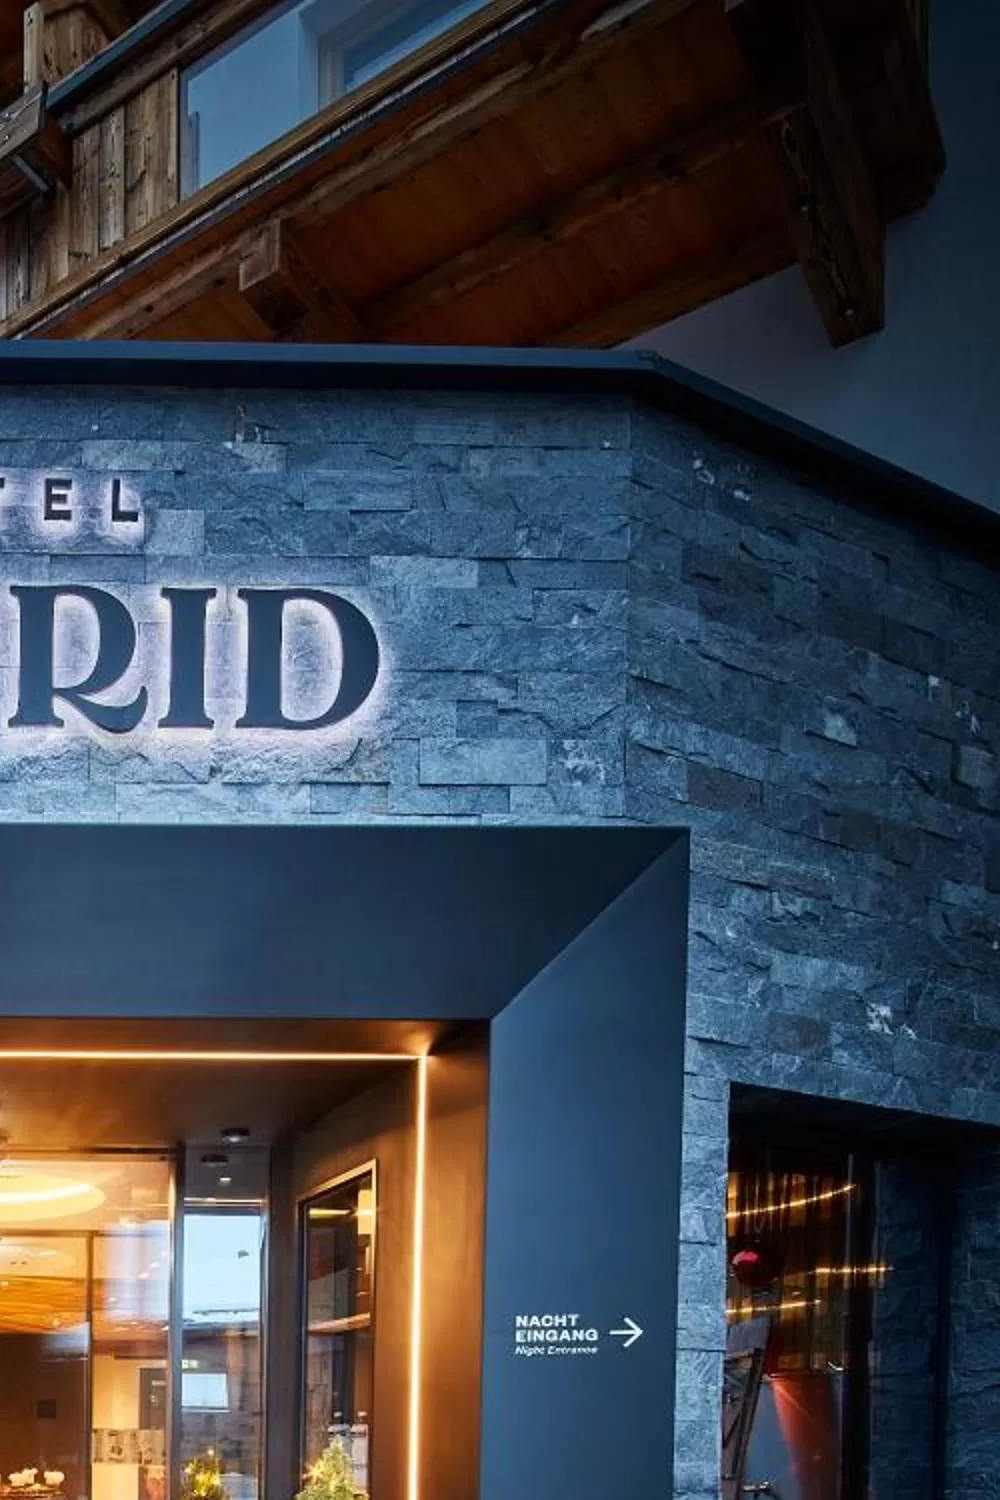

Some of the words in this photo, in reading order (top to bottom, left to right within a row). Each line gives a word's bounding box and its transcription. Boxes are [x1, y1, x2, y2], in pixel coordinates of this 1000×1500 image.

[515, 1314, 579, 1327] NACHT
[515, 1329, 599, 1343] EINGANG
[515, 1346, 545, 1356] Night
[548, 1346, 599, 1355] Entrance
